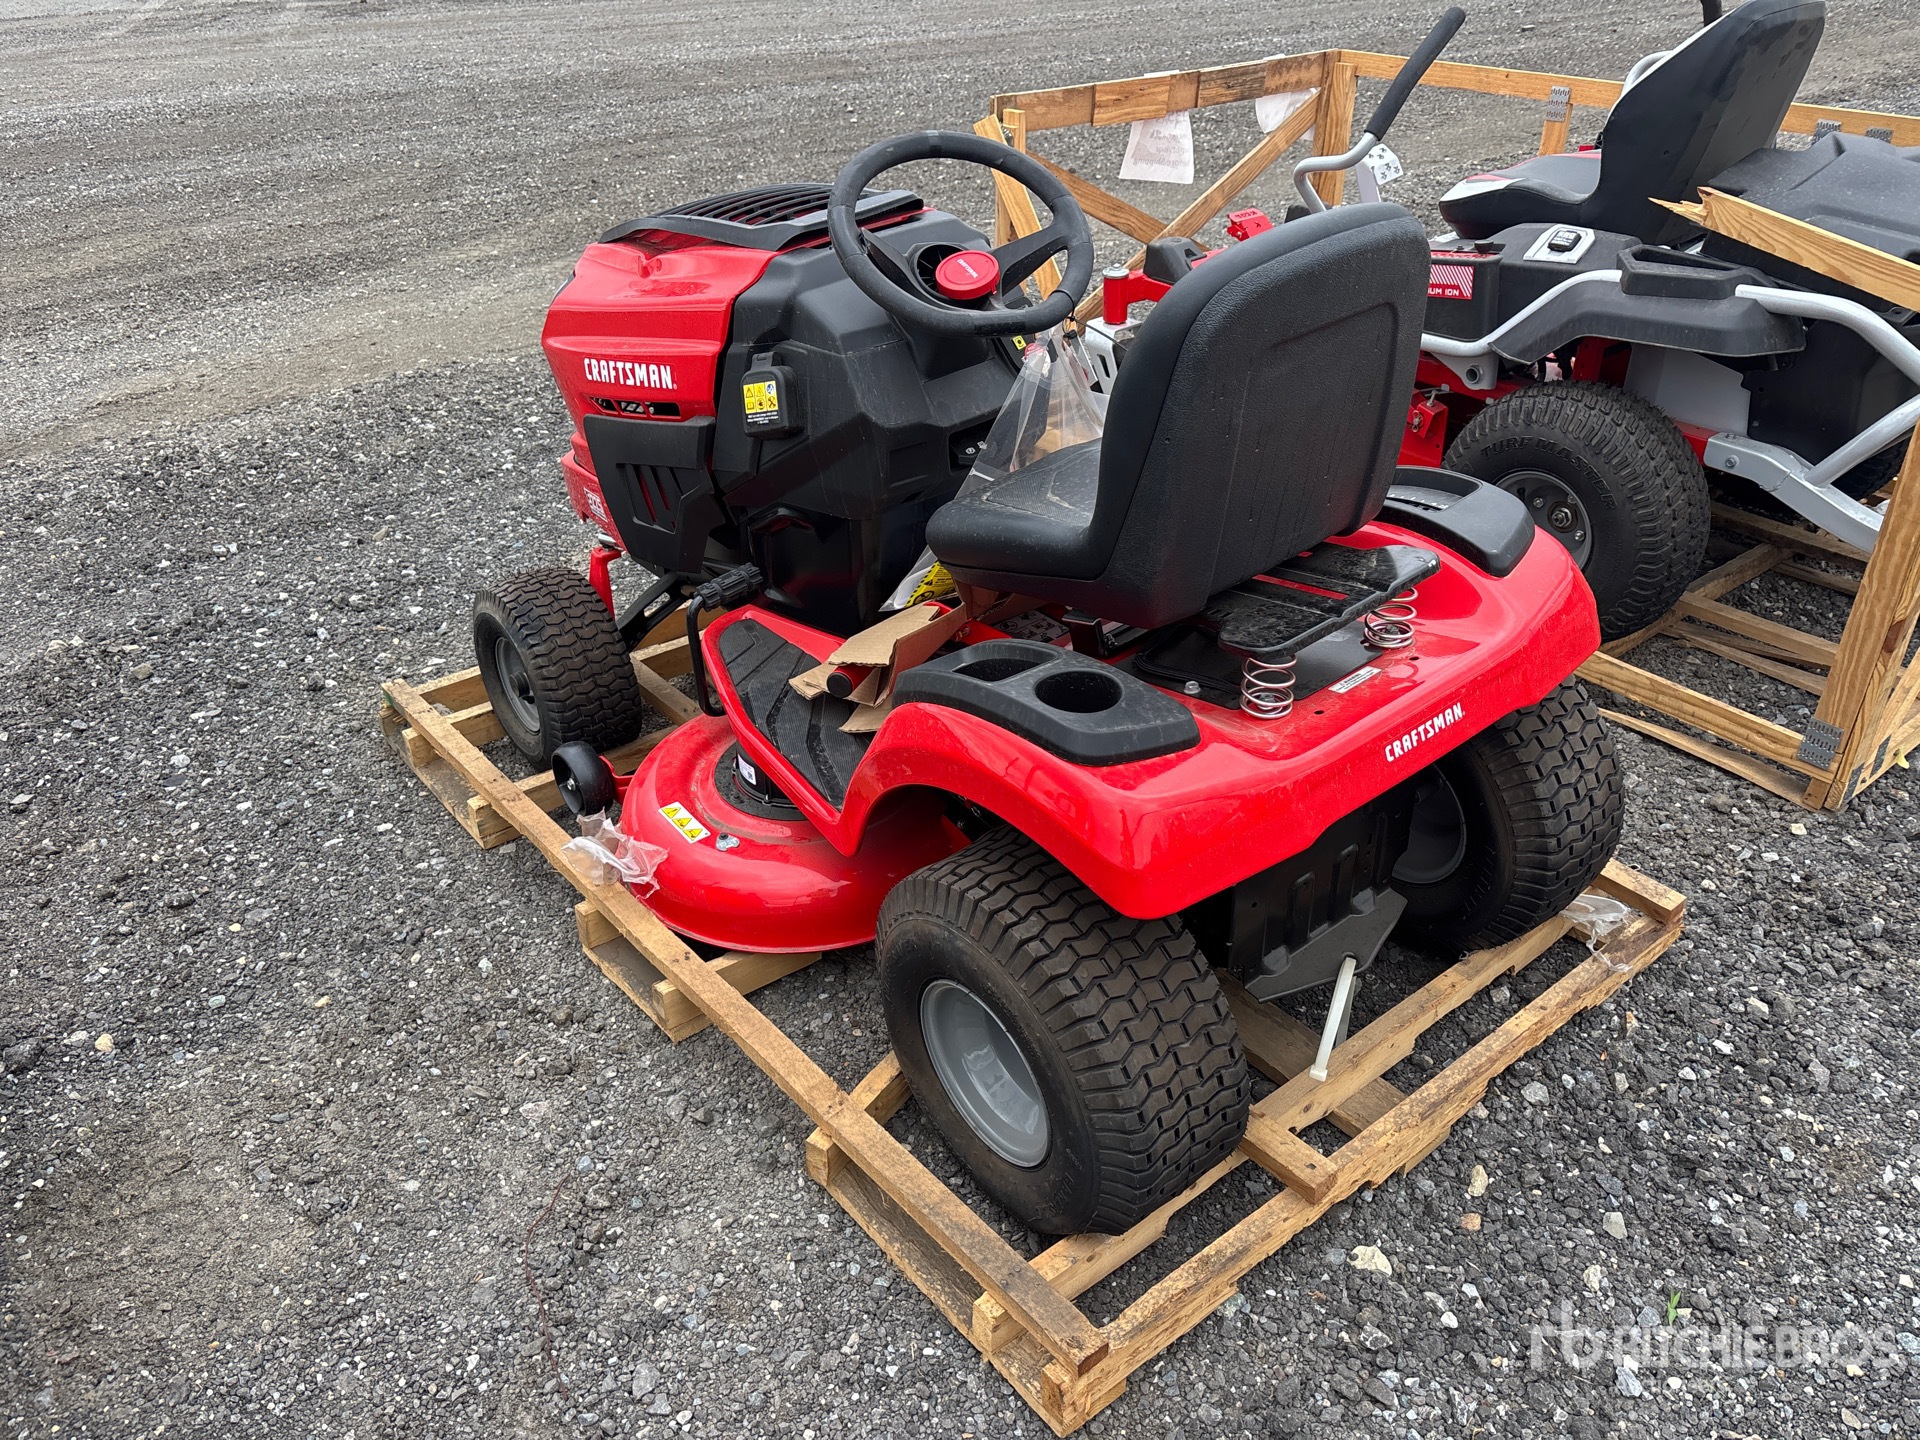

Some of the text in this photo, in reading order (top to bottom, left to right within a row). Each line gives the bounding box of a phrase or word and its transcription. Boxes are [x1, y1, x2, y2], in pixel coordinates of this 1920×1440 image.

[1445, 288, 1460, 297] ION
[583, 357, 673, 390] CRAFTSMAN
[1480, 435, 1617, 511] TURF MASTER
[1384, 702, 1464, 762] CRAFTSMAN
